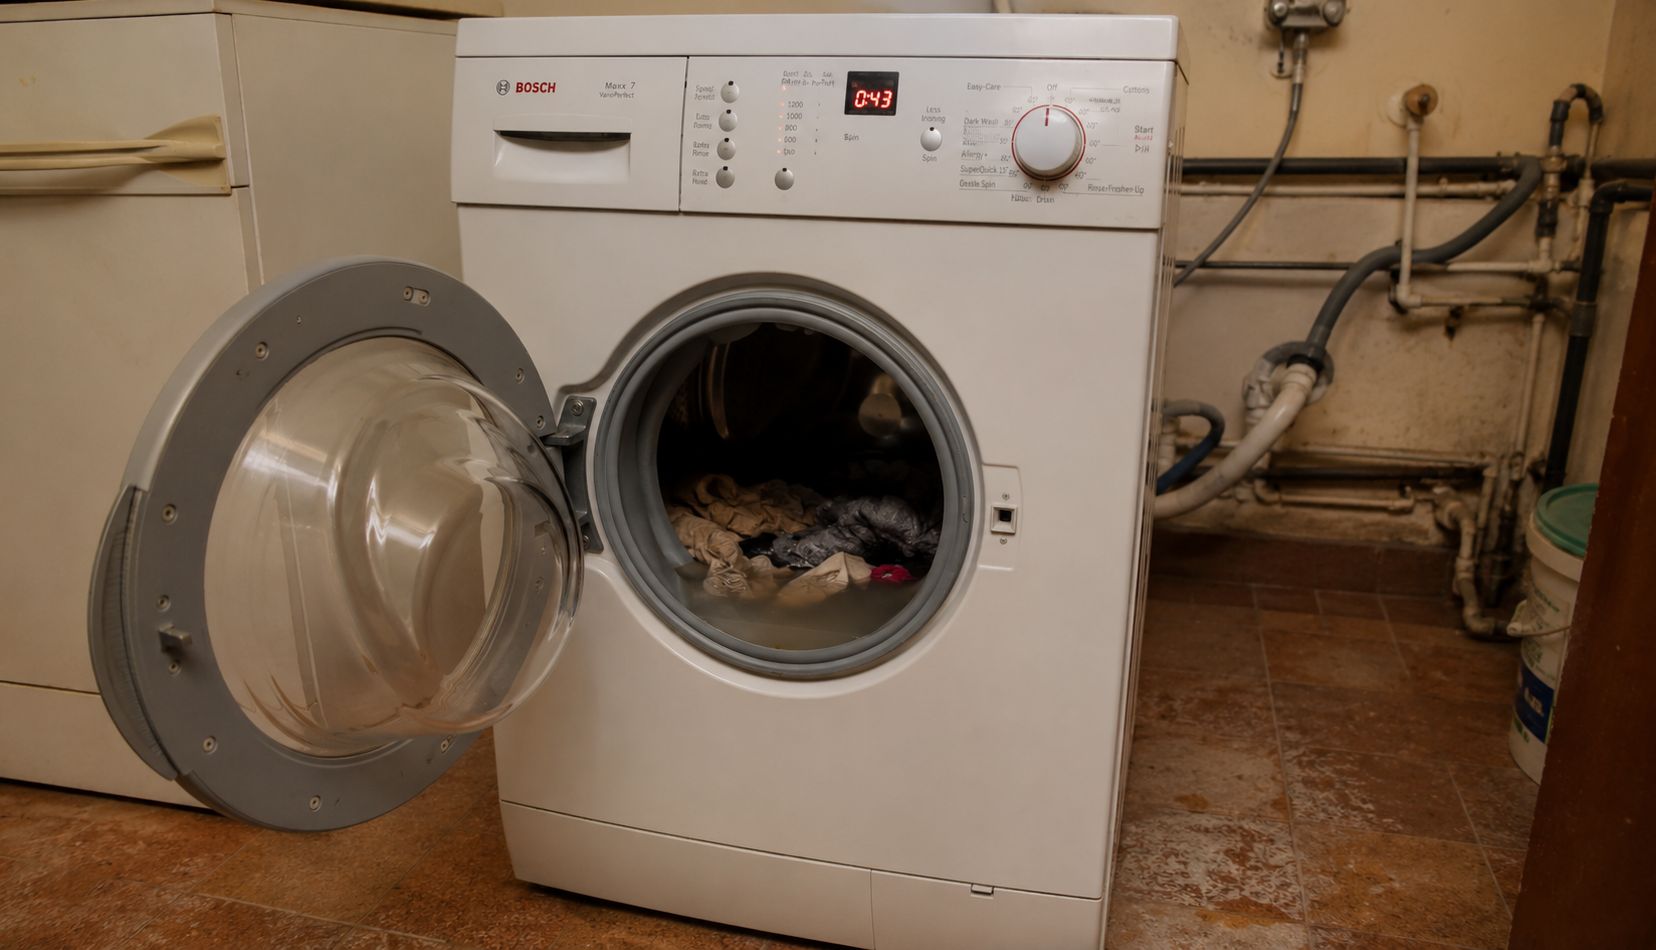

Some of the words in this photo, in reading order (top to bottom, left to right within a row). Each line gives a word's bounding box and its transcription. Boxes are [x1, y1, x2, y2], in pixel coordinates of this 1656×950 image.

[515, 82, 557, 94] BOSCH
[630, 82, 636, 90] 7
[967, 82, 1001, 92] Easy-Care
[854, 90, 893, 108] 0:43
[921, 115, 946, 124] Ironing
[1134, 126, 1154, 134] Start
[844, 134, 860, 142] Spin
[922, 154, 937, 162] Spin
